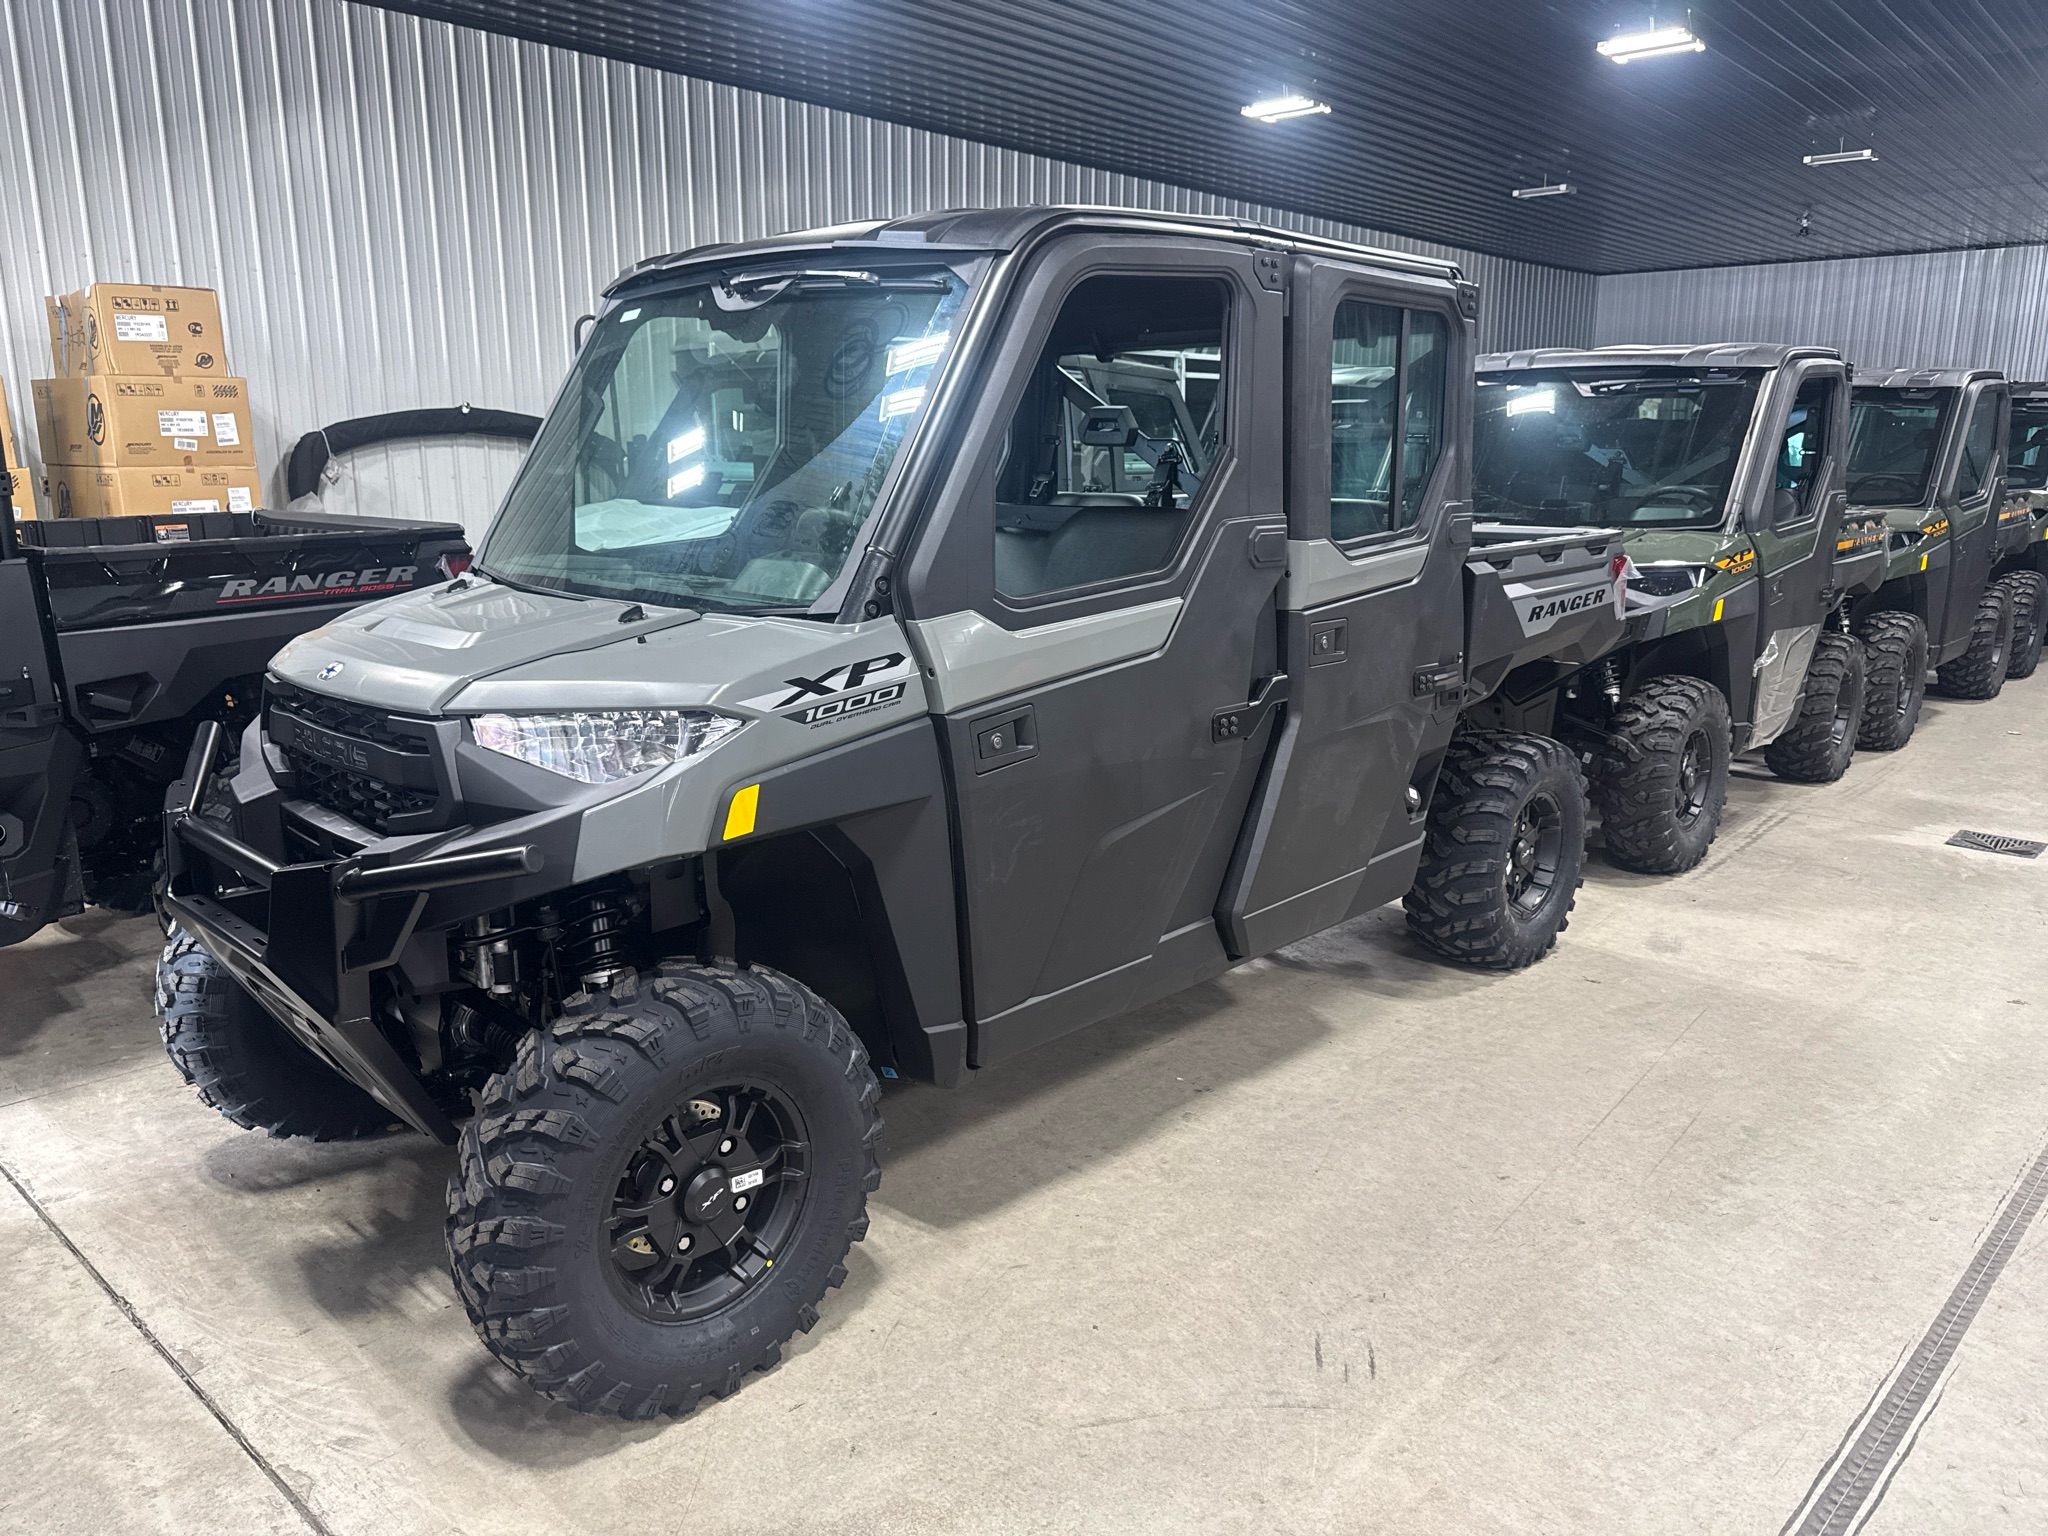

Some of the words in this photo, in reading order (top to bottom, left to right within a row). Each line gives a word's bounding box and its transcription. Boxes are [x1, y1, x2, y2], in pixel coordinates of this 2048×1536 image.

[1724, 548, 1752, 567] XP
[1731, 562, 1752, 575] 1000
[220, 565, 419, 598] RANGER
[323, 586, 358, 595] TRAIL
[360, 583, 395, 592] BOSS
[1528, 589, 1606, 622] RANGER
[770, 652, 907, 709] XP
[805, 685, 900, 723] 1000
[810, 720, 834, 730] DUAL
[836, 706, 882, 722] OVERHEAD
[882, 700, 902, 710] CAM
[293, 727, 368, 770] POLARIS
[701, 1188, 724, 1211] XP
